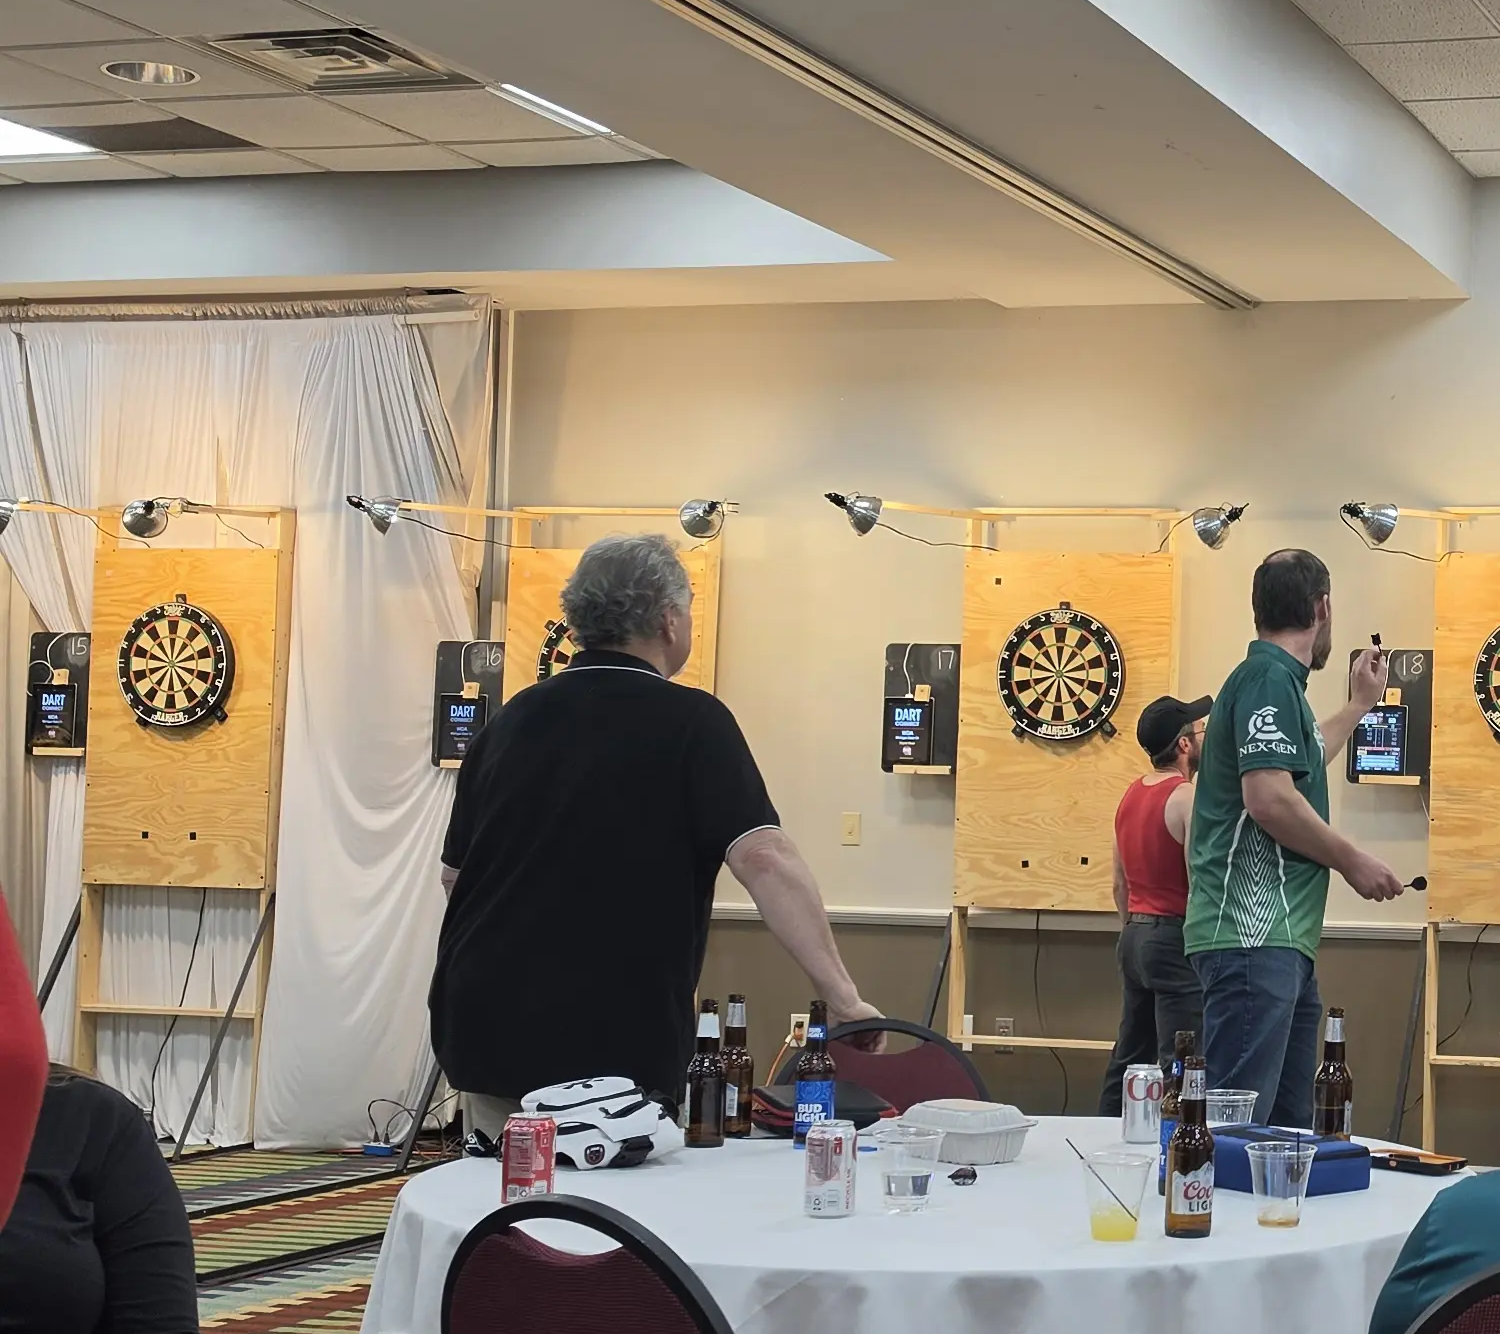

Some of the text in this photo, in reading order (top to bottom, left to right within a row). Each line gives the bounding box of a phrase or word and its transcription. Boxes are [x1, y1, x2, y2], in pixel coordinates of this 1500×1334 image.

[71, 637, 87, 655] 15
[486, 644, 502, 666] 16
[938, 650, 954, 670] 17
[538, 665, 546, 674] 11
[1403, 653, 1424, 676] 18
[1475, 673, 1484, 682] 11
[42, 693, 66, 706] DART
[450, 705, 476, 718] DART
[894, 708, 922, 722] DART
[1239, 741, 1297, 758] NEX-GEN
[797, 1103, 823, 1113] BUD
[794, 1112, 827, 1123] LIGHT
